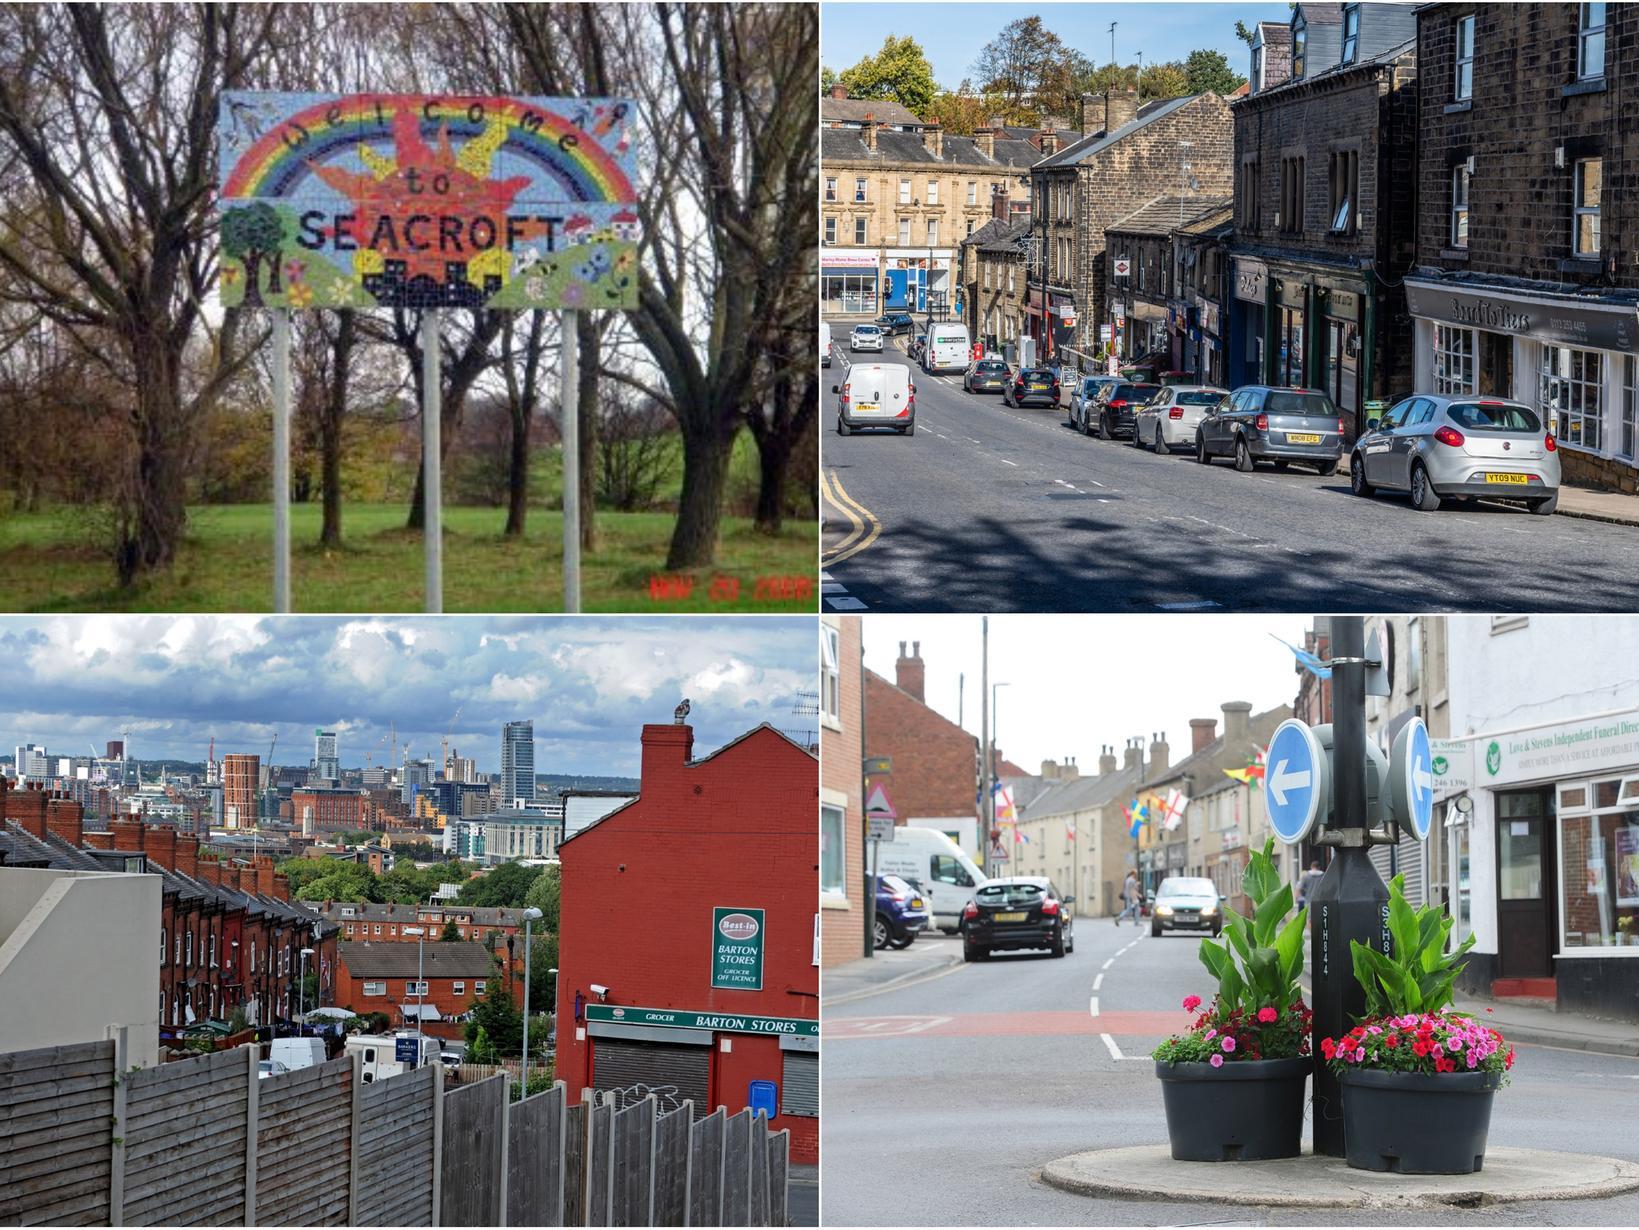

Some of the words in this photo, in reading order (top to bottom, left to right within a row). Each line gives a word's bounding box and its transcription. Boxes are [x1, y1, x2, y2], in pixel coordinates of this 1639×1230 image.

[405, 168, 450, 196] to
[295, 210, 564, 252] SEACROFT
[1488, 474, 1509, 482] YT09
[1510, 475, 1525, 483] NUC
[1509, 742, 1523, 754] Love
[1524, 739, 1530, 752] &
[1531, 737, 1553, 749] Stevens
[1554, 731, 1593, 747] Independent
[1594, 723, 1620, 740] Funeral
[722, 920, 756, 931] Best-in
[718, 945, 758, 956] BARTON
[719, 954, 756, 965] STORES
[731, 975, 757, 983] LICENCE
[645, 1013, 675, 1022] GROCER
[695, 1016, 745, 1030] BARTON
[751, 1020, 797, 1034] STORES
